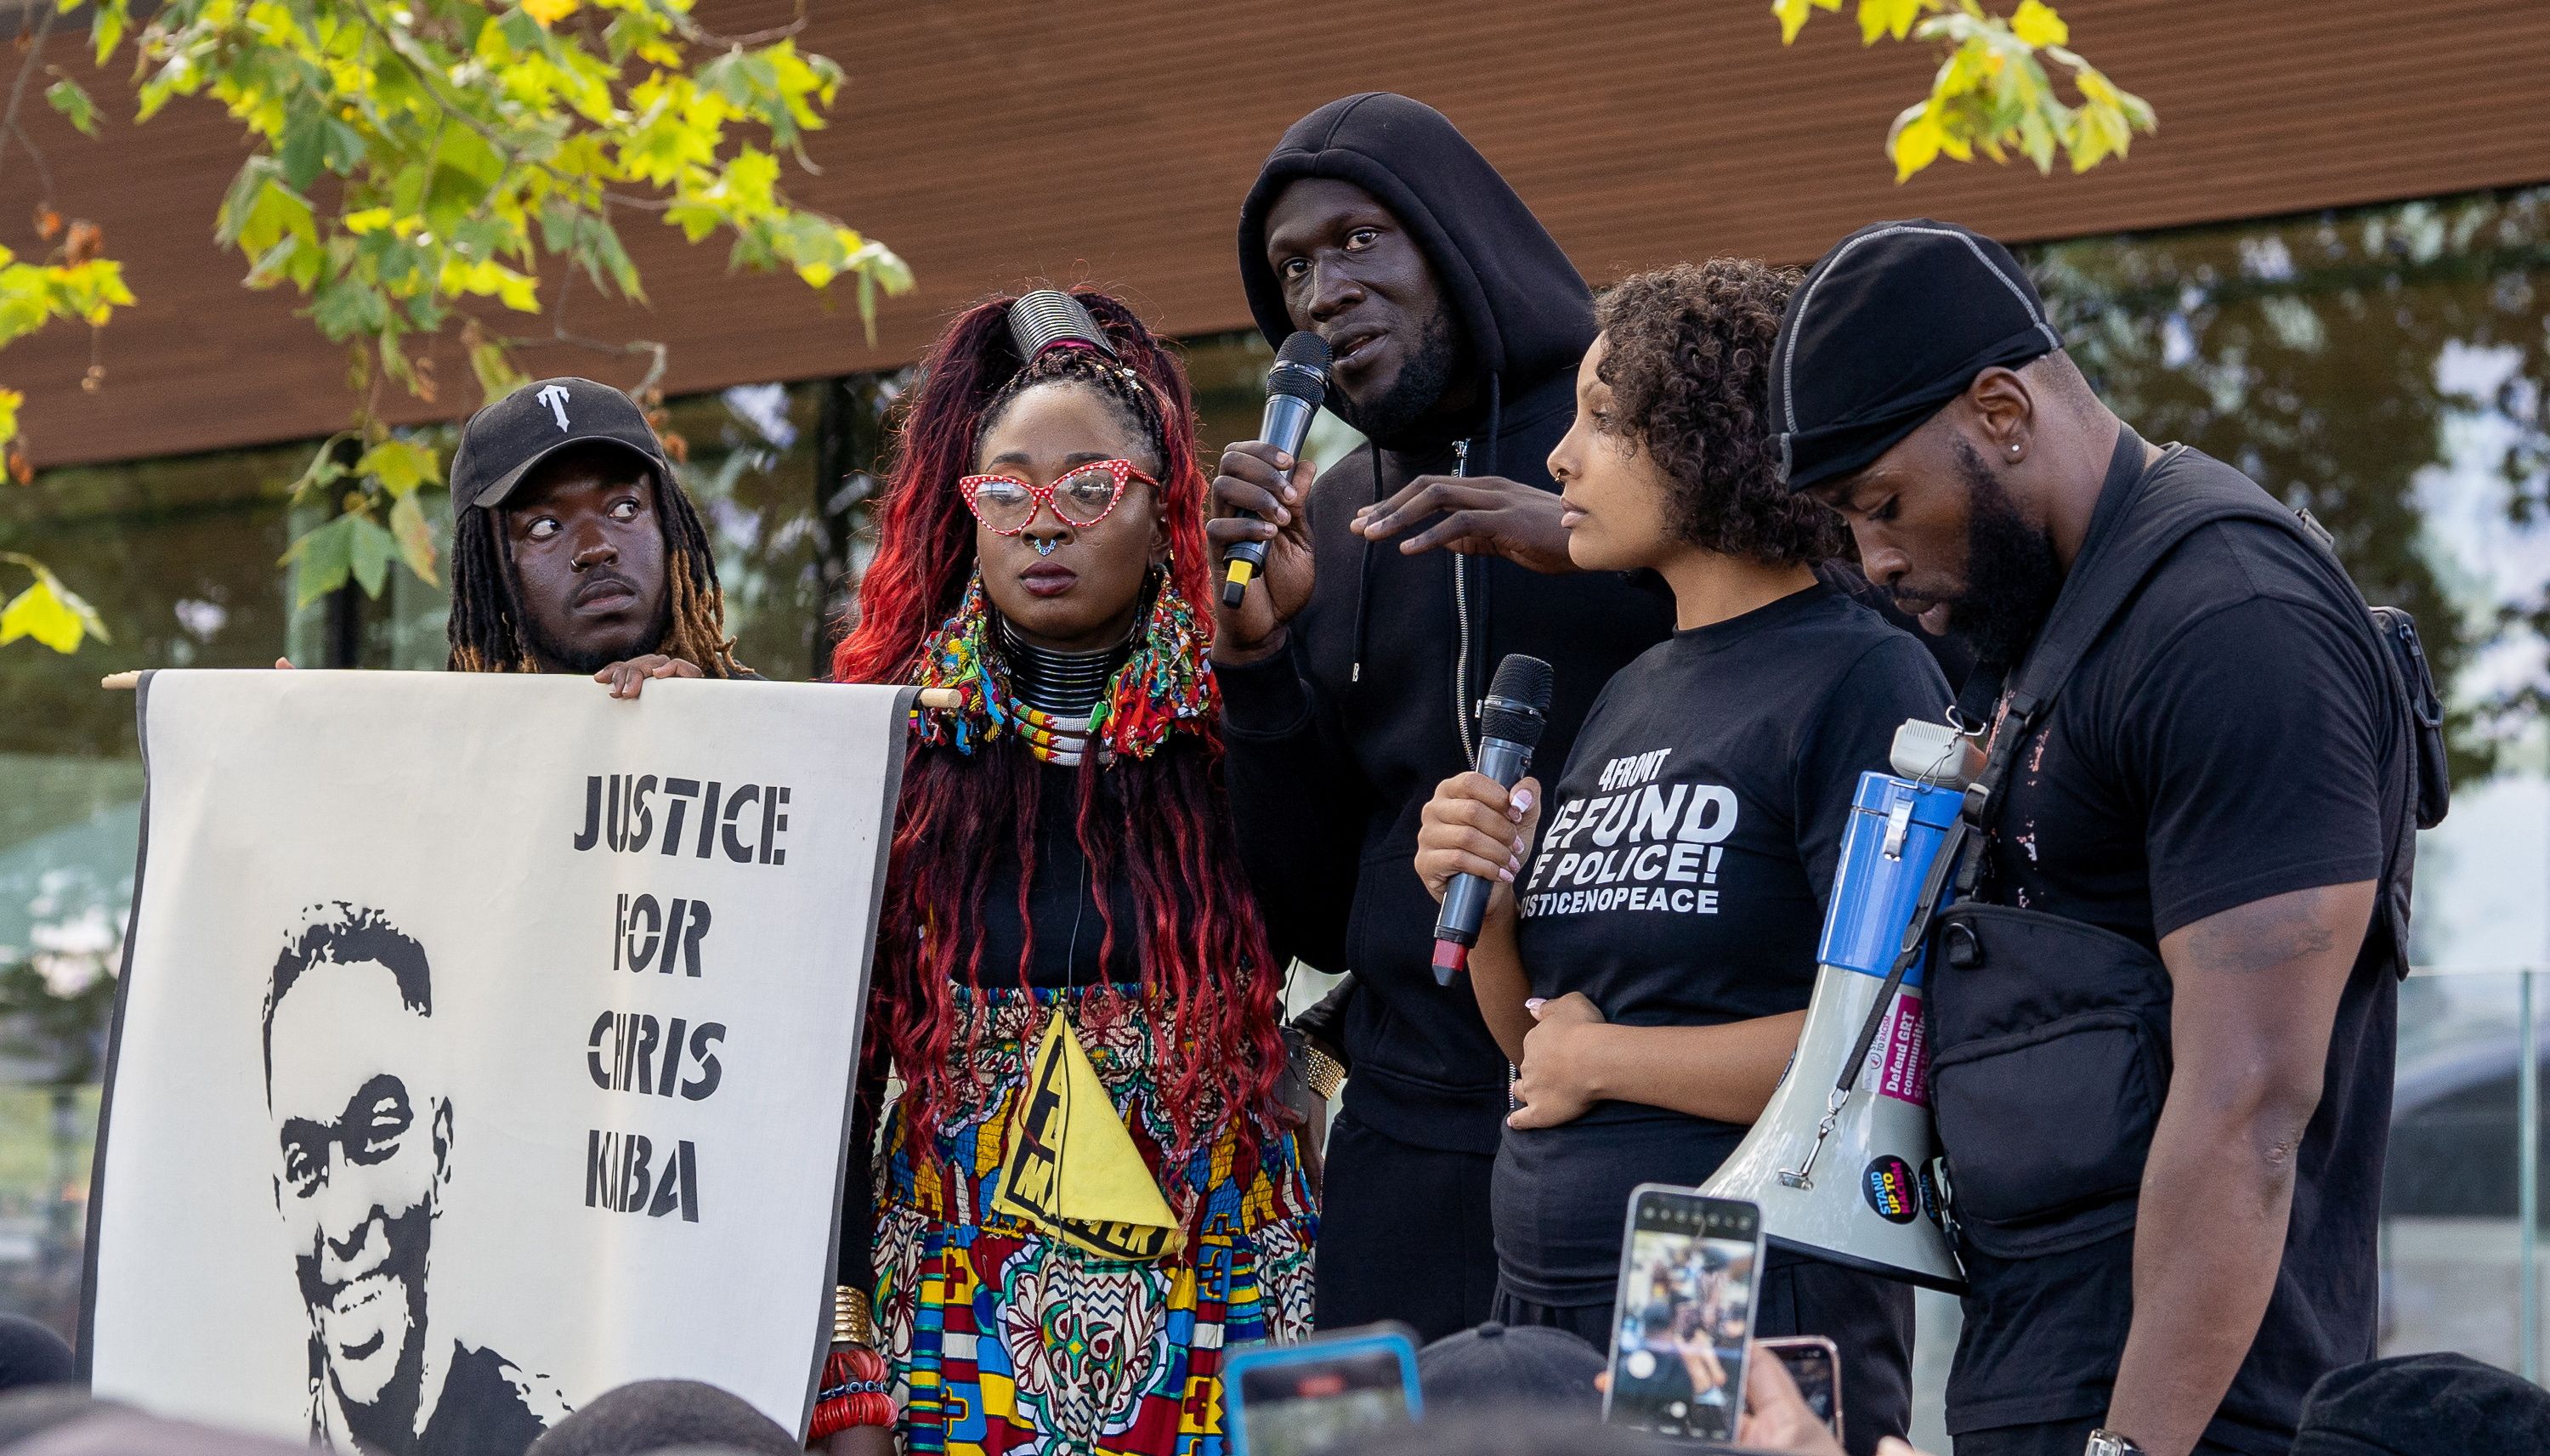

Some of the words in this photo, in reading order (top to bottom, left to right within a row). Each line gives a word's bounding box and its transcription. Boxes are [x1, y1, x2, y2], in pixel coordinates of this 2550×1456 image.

[1598, 748, 1672, 792] 4FRONT
[574, 774, 790, 865] JUSTICE
[1542, 784, 1738, 853] EFUND
[1547, 843, 1723, 888] POLICE!
[613, 893, 712, 977] FOR
[1896, 1011, 1915, 1042] GRT
[1886, 1043, 1907, 1092] Defend
[1871, 1171, 1891, 1215] STAND
[1883, 1172, 1895, 1193] TO
[1888, 1194, 1901, 1214] UP
[1890, 1161, 1911, 1214] RACISM
